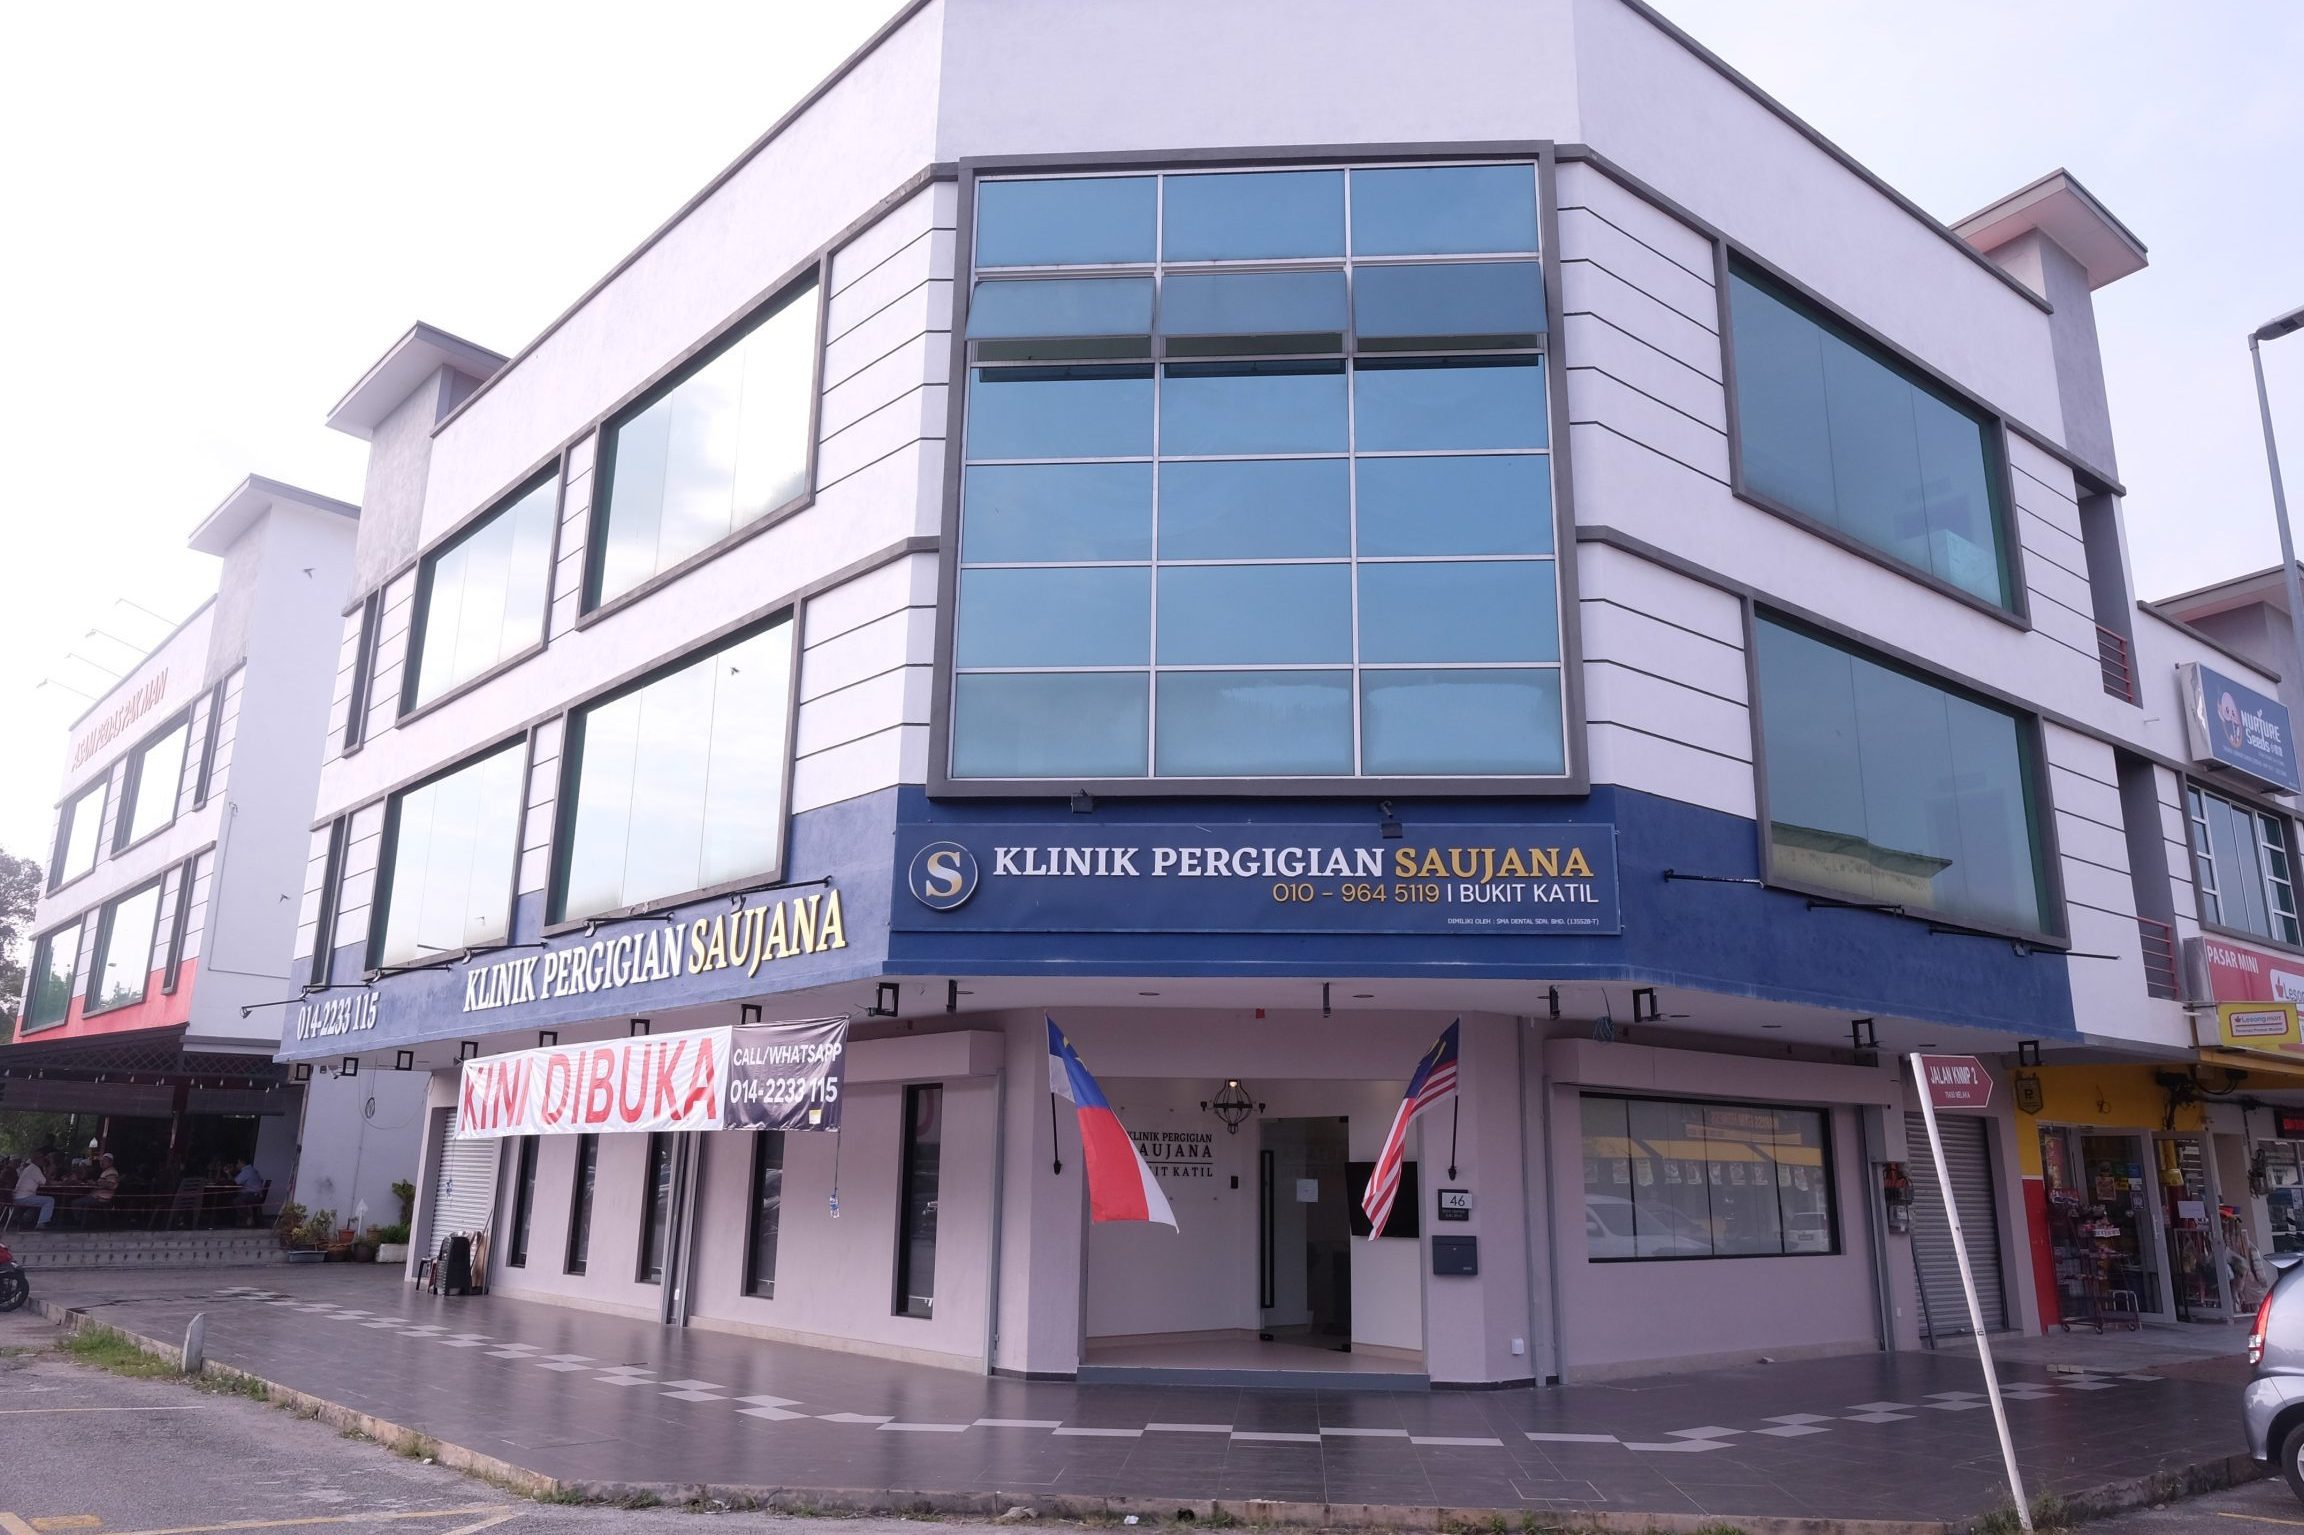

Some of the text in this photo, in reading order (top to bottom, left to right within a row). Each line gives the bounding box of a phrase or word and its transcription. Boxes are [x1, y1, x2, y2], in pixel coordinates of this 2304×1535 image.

[140, 667, 169, 717] MAN
[2240, 709, 2281, 743] NURTURE
[926, 851, 963, 897] S
[993, 847, 1594, 884] KLINIK PERGIGIAN SAUJANA
[1272, 883, 1314, 903] 010
[1341, 883, 1387, 903] 964
[1394, 883, 1440, 903] 5119
[1460, 884, 1526, 903] BUKIT
[1533, 884, 1599, 903] KATIL
[1511, 917, 1534, 925] DENTAL
[463, 888, 848, 1013] KLINIK PERGIGIAN SAUJANA
[2207, 945, 2260, 975] PASAR MINI
[296, 991, 380, 1041] 014-2233 115
[733, 1042, 843, 1067] CALL/WHATSAPP
[460, 1037, 717, 1132] KINI DIBUKA
[1929, 1066, 1954, 1085] JALAN
[1971, 1066, 1978, 1085] 2
[730, 1076, 838, 1105] 014-2233 115
[1139, 1143, 1213, 1159] AUJANA
[1162, 1132, 1212, 1143] PERGIGIAN
[1173, 1167, 1213, 1177] KATIL
[1449, 1195, 1465, 1207] 46
